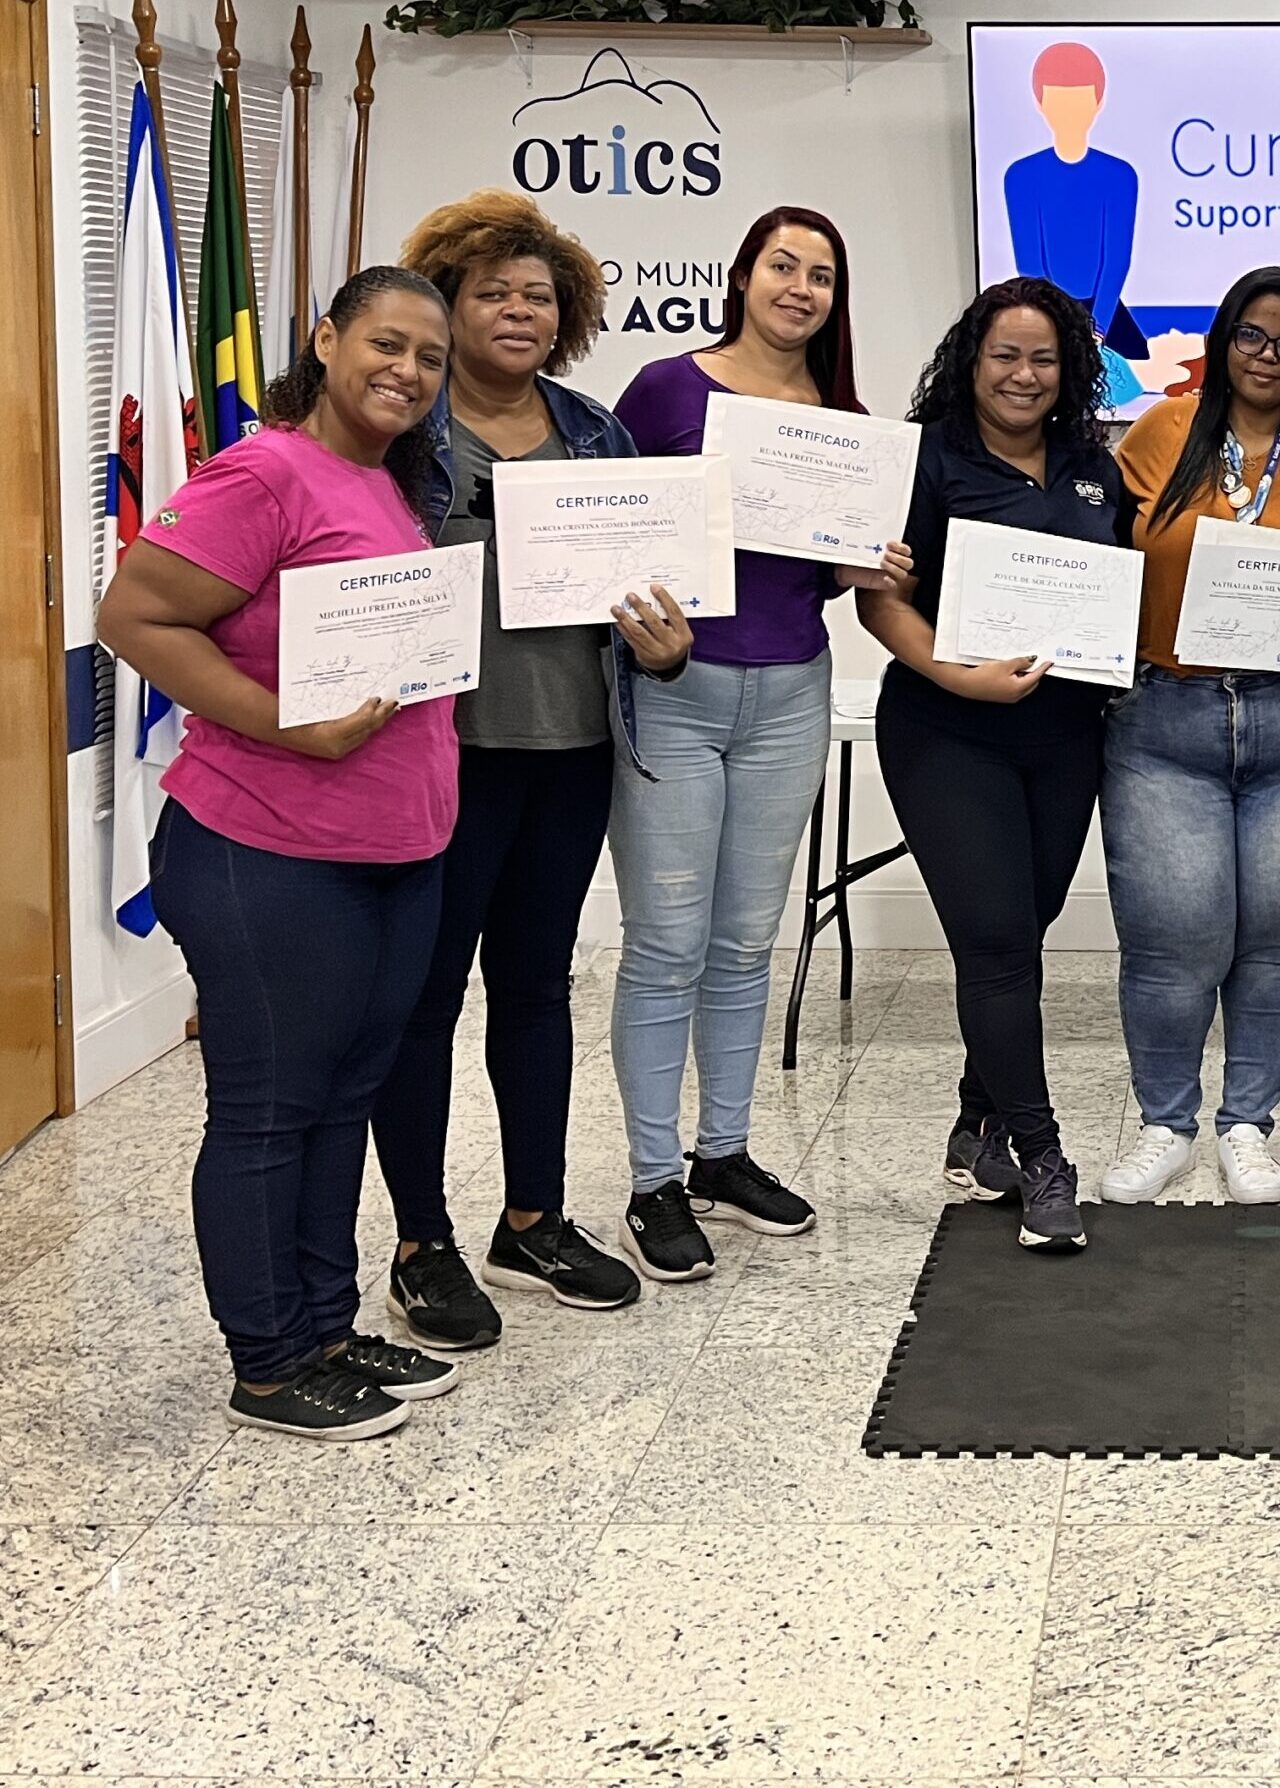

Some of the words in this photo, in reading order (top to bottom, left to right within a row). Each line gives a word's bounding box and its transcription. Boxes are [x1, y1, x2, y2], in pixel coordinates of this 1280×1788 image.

[512, 124, 722, 197] otics
[637, 261, 723, 288] MUNI
[620, 296, 729, 335] AGU
[778, 425, 860, 450] CERTIFICADO
[556, 494, 649, 508] CERTIFICADO
[823, 534, 840, 545] Rio
[1011, 552, 1088, 571] CERTIFICADO
[340, 567, 432, 591] CERTIFICADO
[1066, 649, 1082, 659] Rio
[410, 682, 428, 693] Rio
